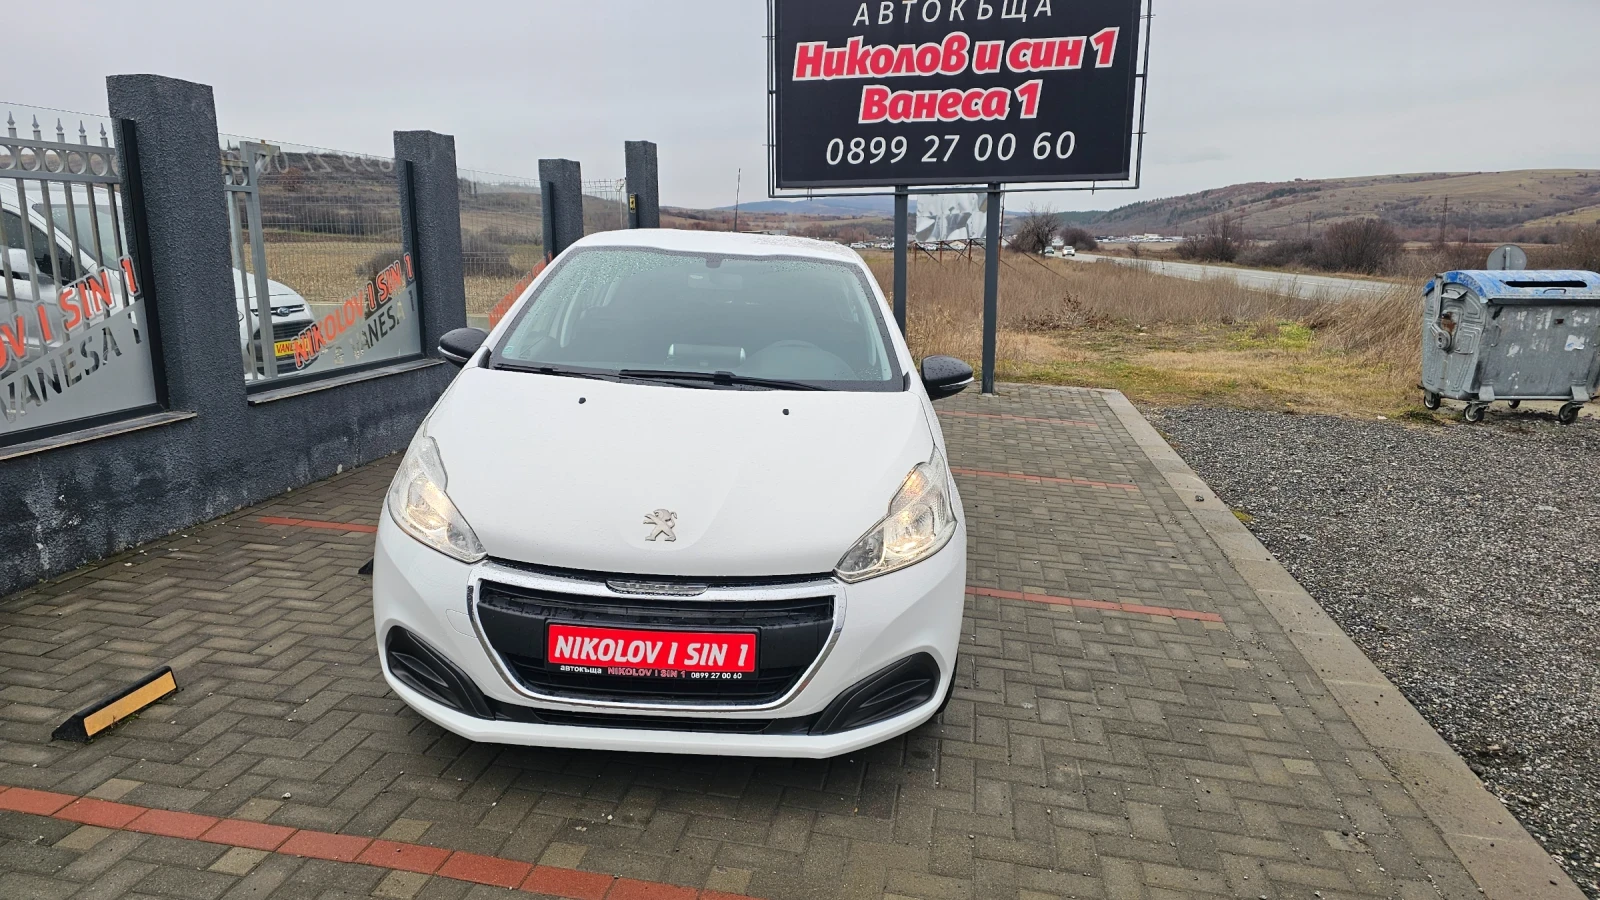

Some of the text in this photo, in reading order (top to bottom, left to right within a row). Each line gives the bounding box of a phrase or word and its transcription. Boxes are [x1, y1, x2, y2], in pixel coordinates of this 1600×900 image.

[852, 0, 1052, 26] АВТОКЪЩА
[792, 27, 1120, 80] Николов и син 1
[858, 79, 1042, 124] Ванеса 1
[826, 131, 1076, 165] 0899 27 00 60
[58, 268, 115, 332] SIN
[119, 254, 140, 296] 1
[291, 252, 414, 369] NIKOLOV I SIN 1
[555, 635, 749, 667] NIKOLOV I SIN 1
[560, 665, 602, 674] автокъща
[607, 667, 653, 677] NIKOLOV
[660, 669, 678, 678] SIN
[680, 670, 686, 678] 1
[722, 672, 732, 680] 00
[733, 672, 742, 680] 60
